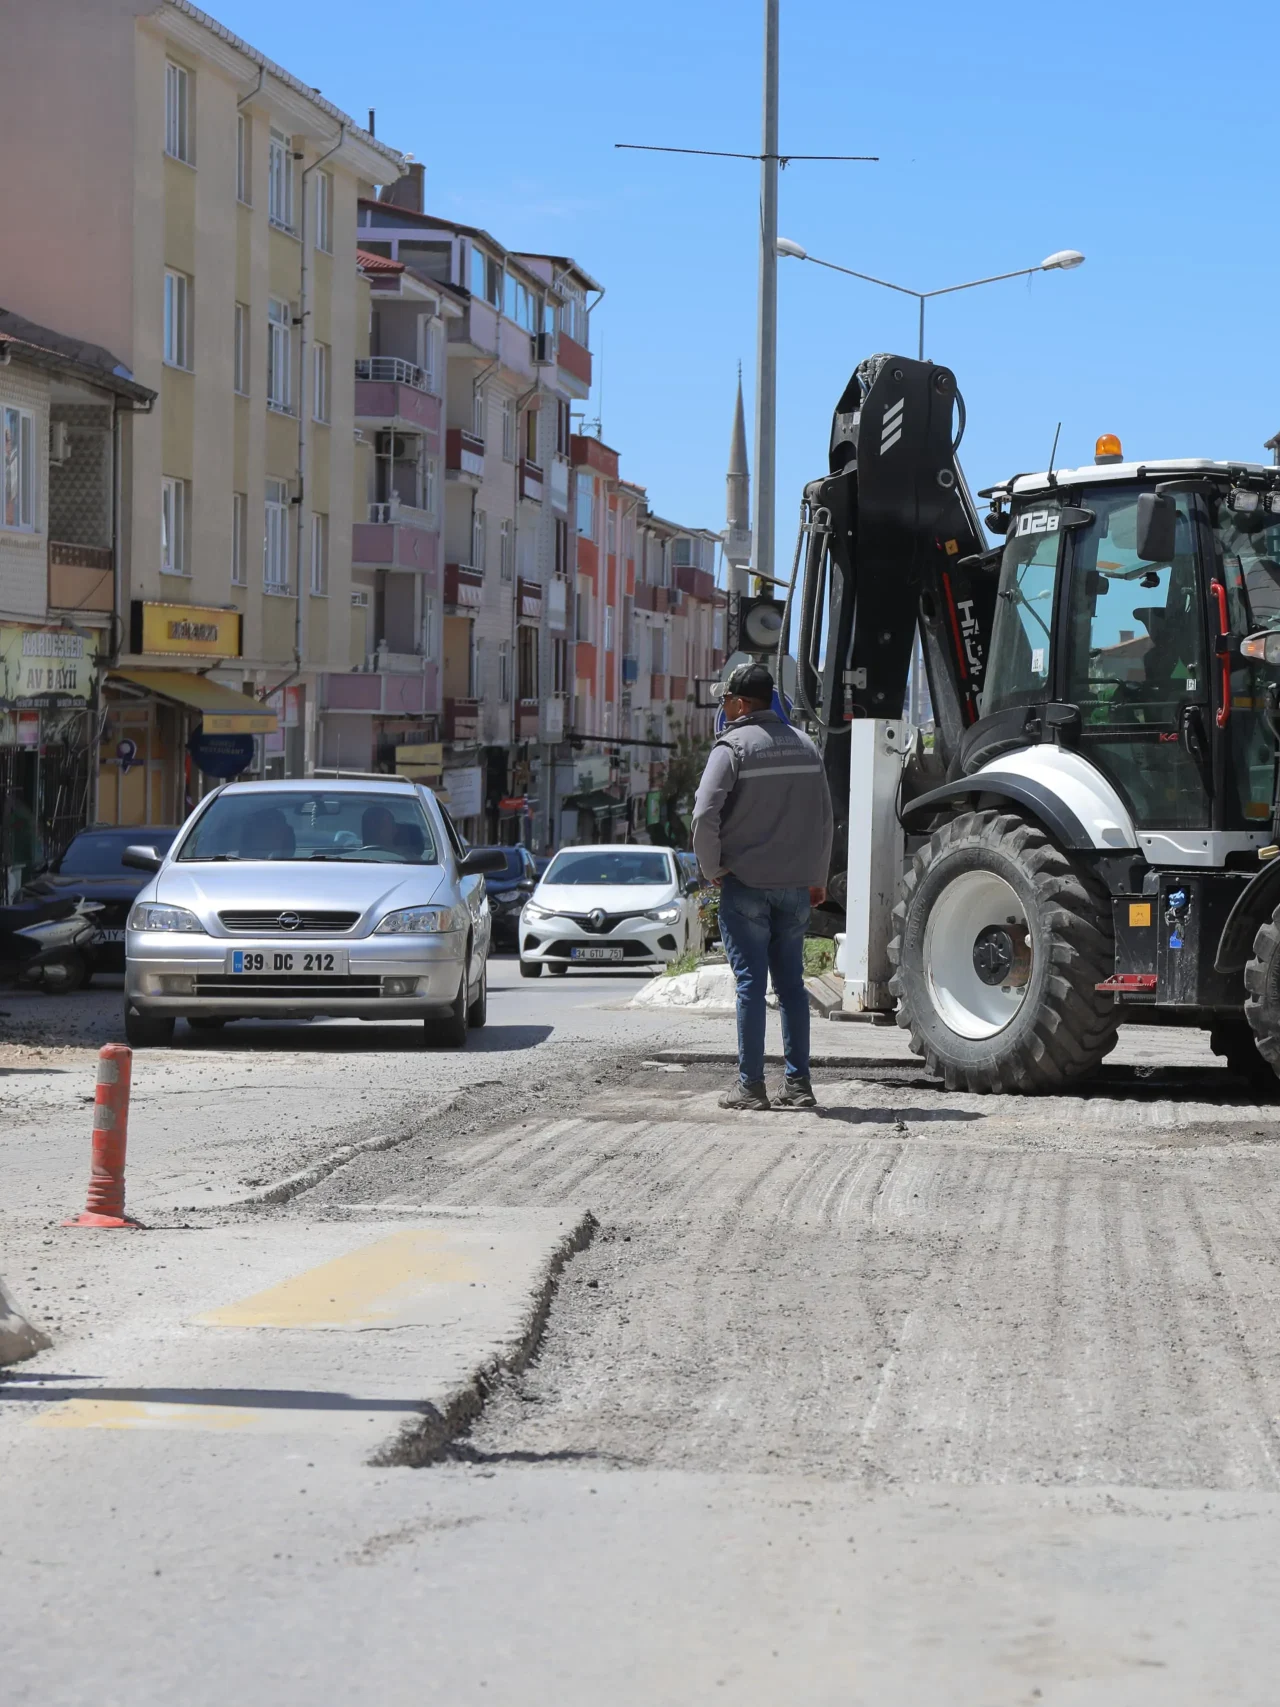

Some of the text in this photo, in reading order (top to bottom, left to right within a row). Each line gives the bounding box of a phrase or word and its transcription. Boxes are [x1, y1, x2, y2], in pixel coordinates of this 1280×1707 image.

[27, 668, 43, 689] AV
[244, 953, 334, 971] 39 DC 212
